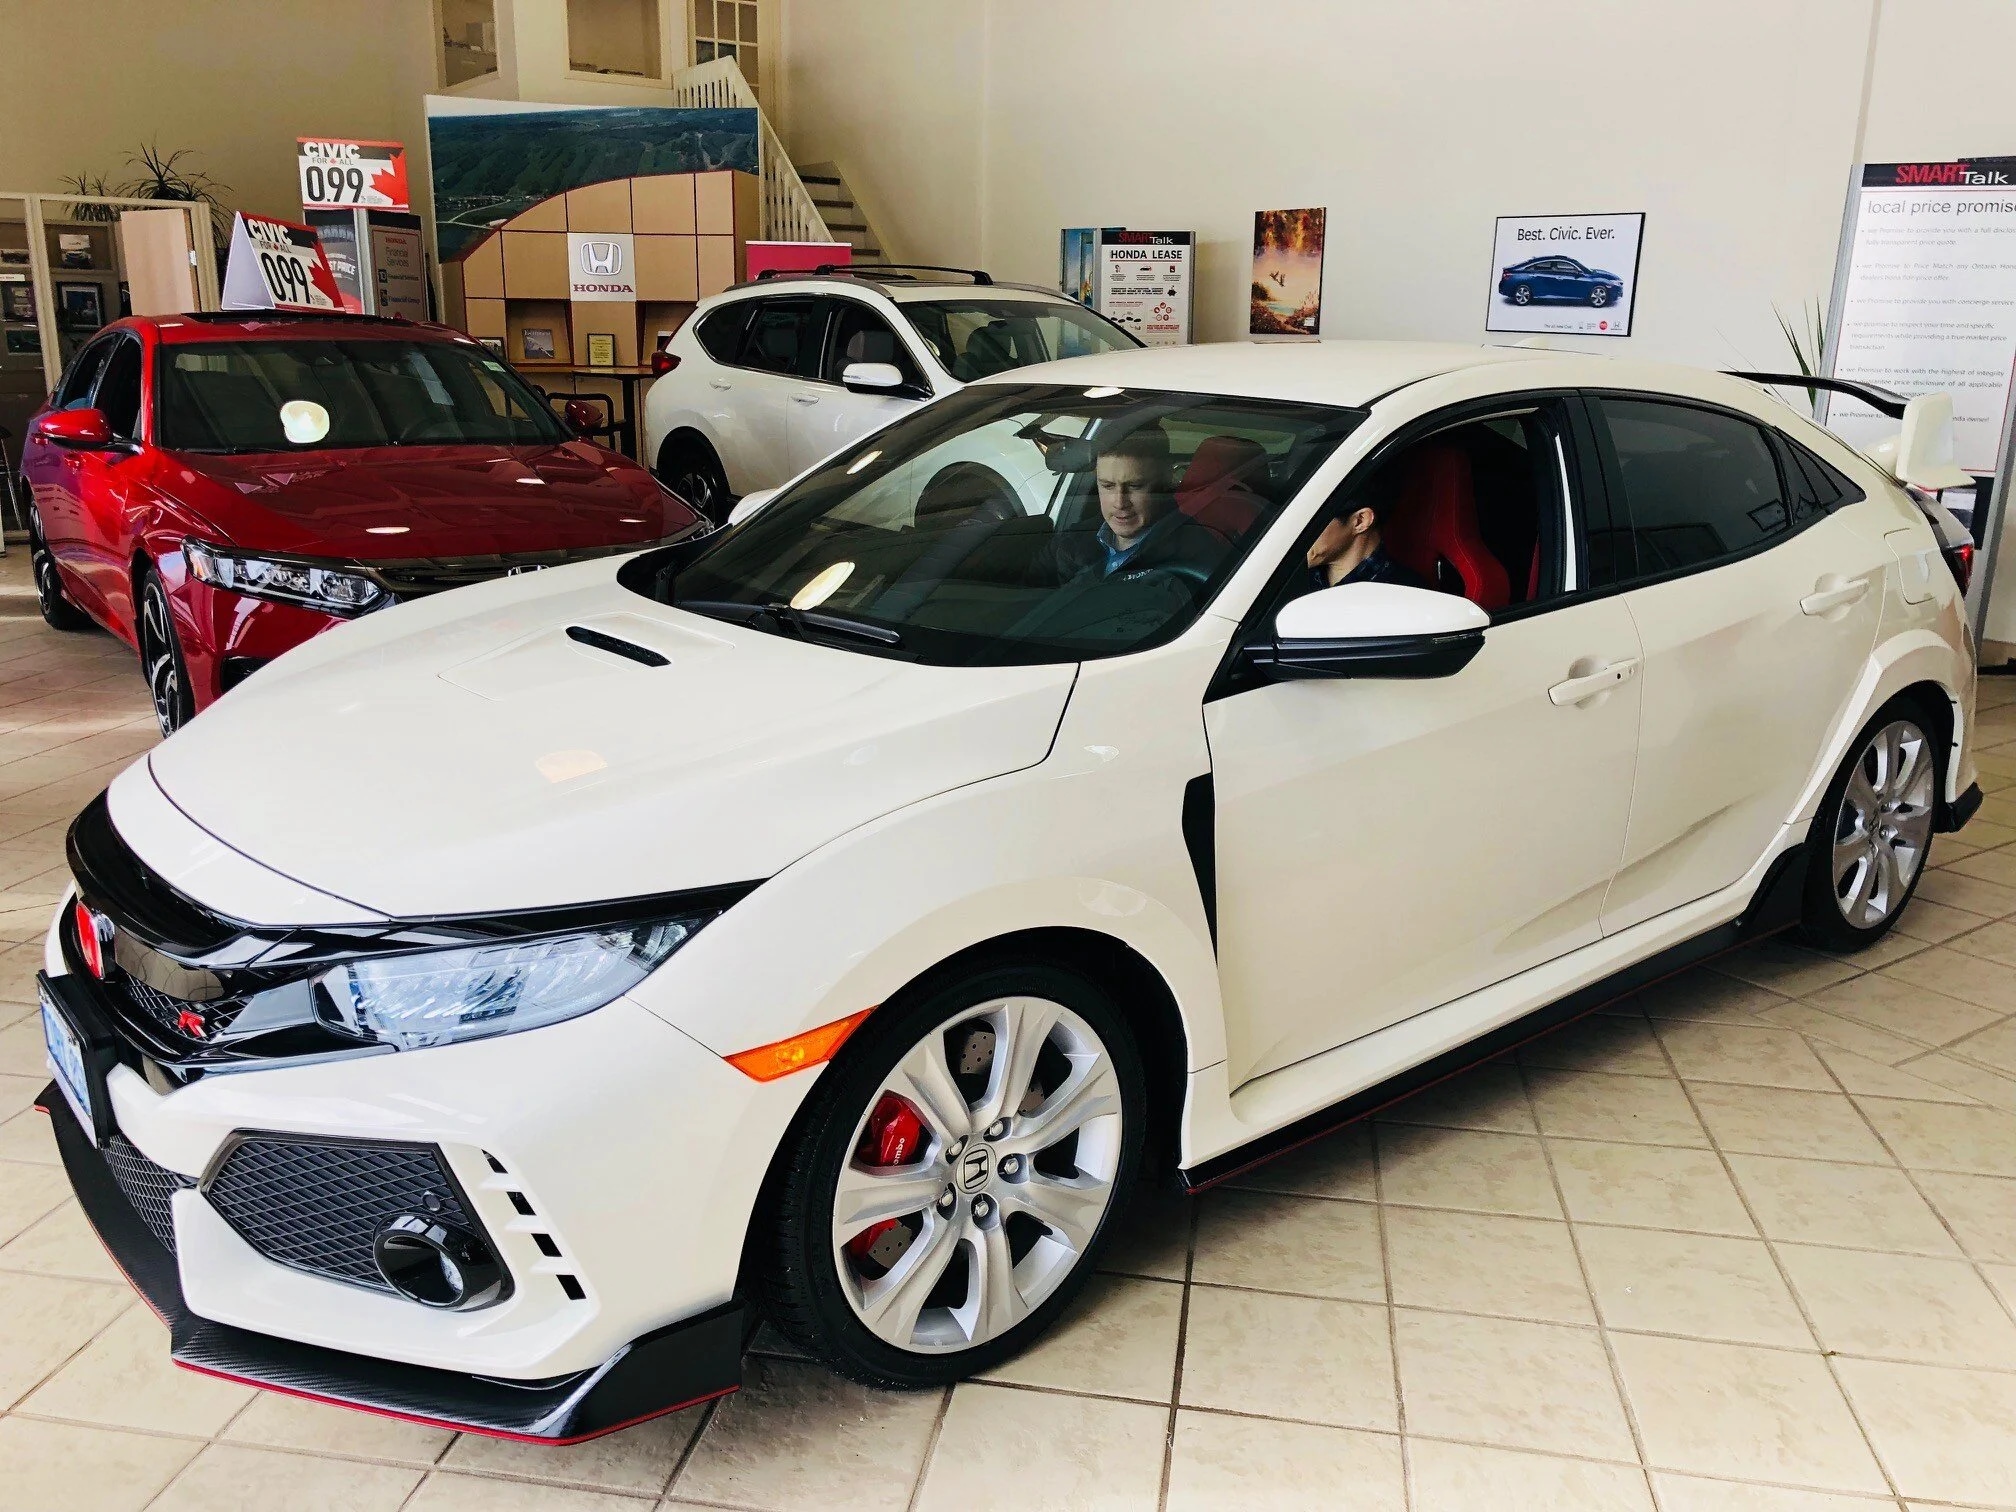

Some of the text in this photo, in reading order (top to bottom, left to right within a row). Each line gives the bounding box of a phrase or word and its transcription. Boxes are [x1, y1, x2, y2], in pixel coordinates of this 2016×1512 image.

[303, 142, 360, 159] CIVIC
[1896, 164, 2009, 185] SMART Talk
[306, 166, 363, 203] 0.99
[1868, 199, 2016, 217] local price promis
[248, 219, 292, 246] CIVIC
[1517, 226, 1615, 241] Best. Civic. Ever.
[1916, 227, 1941, 235] provide
[259, 241, 272, 250] FOR
[1149, 236, 1174, 245] Talk
[1110, 250, 1182, 259] HONDA LEASE
[261, 252, 311, 304] 0.99
[573, 284, 634, 293] HONDA
